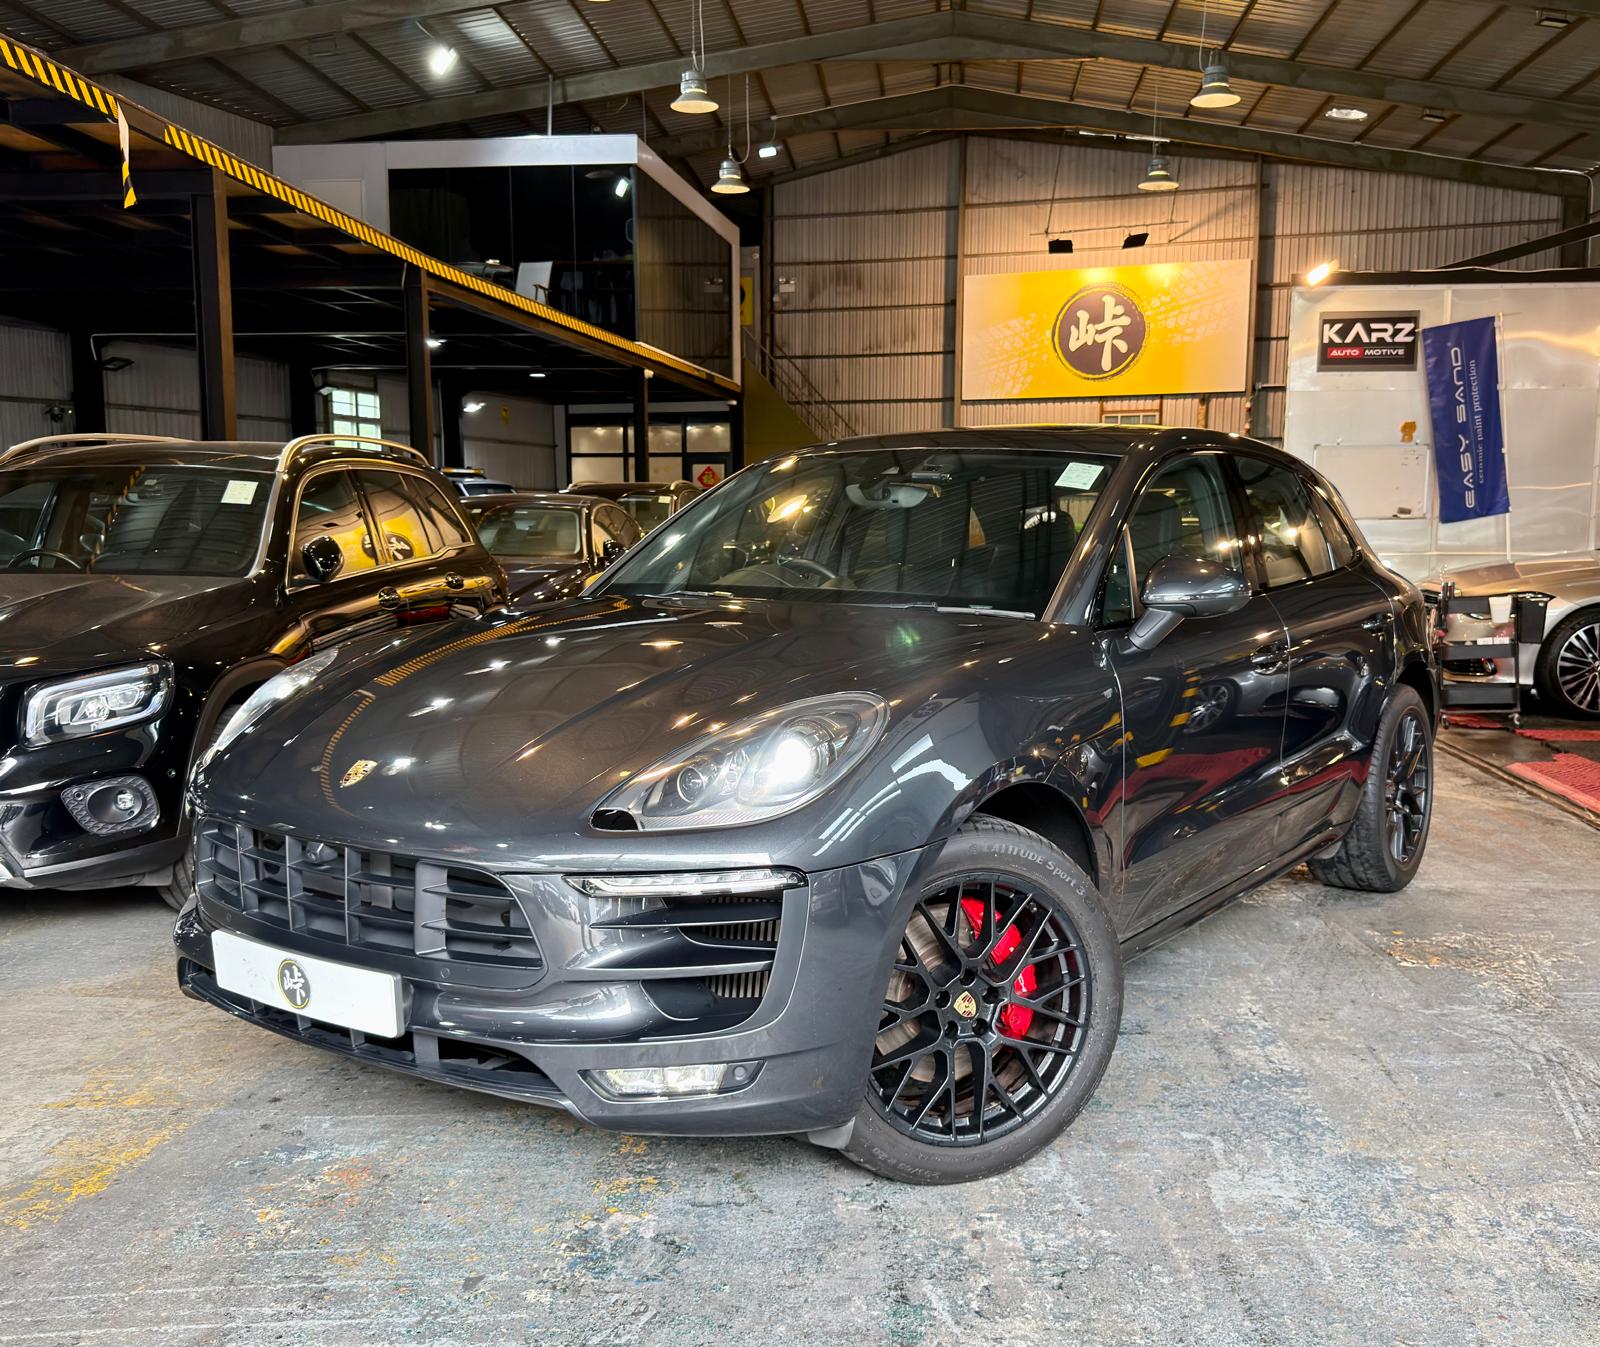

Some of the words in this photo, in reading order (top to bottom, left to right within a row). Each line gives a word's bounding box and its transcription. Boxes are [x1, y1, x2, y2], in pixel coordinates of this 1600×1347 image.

[1068, 294, 1132, 371] 峠
[1322, 322, 1415, 343] KARZ
[1364, 348, 1405, 356] MOTIVE
[1451, 347, 1467, 423] SAND
[1469, 360, 1483, 411] protection
[1474, 415, 1484, 440] paint
[1458, 434, 1475, 508] EASY
[1046, 861, 1077, 887] Sport
[283, 965, 306, 1006] 峠
